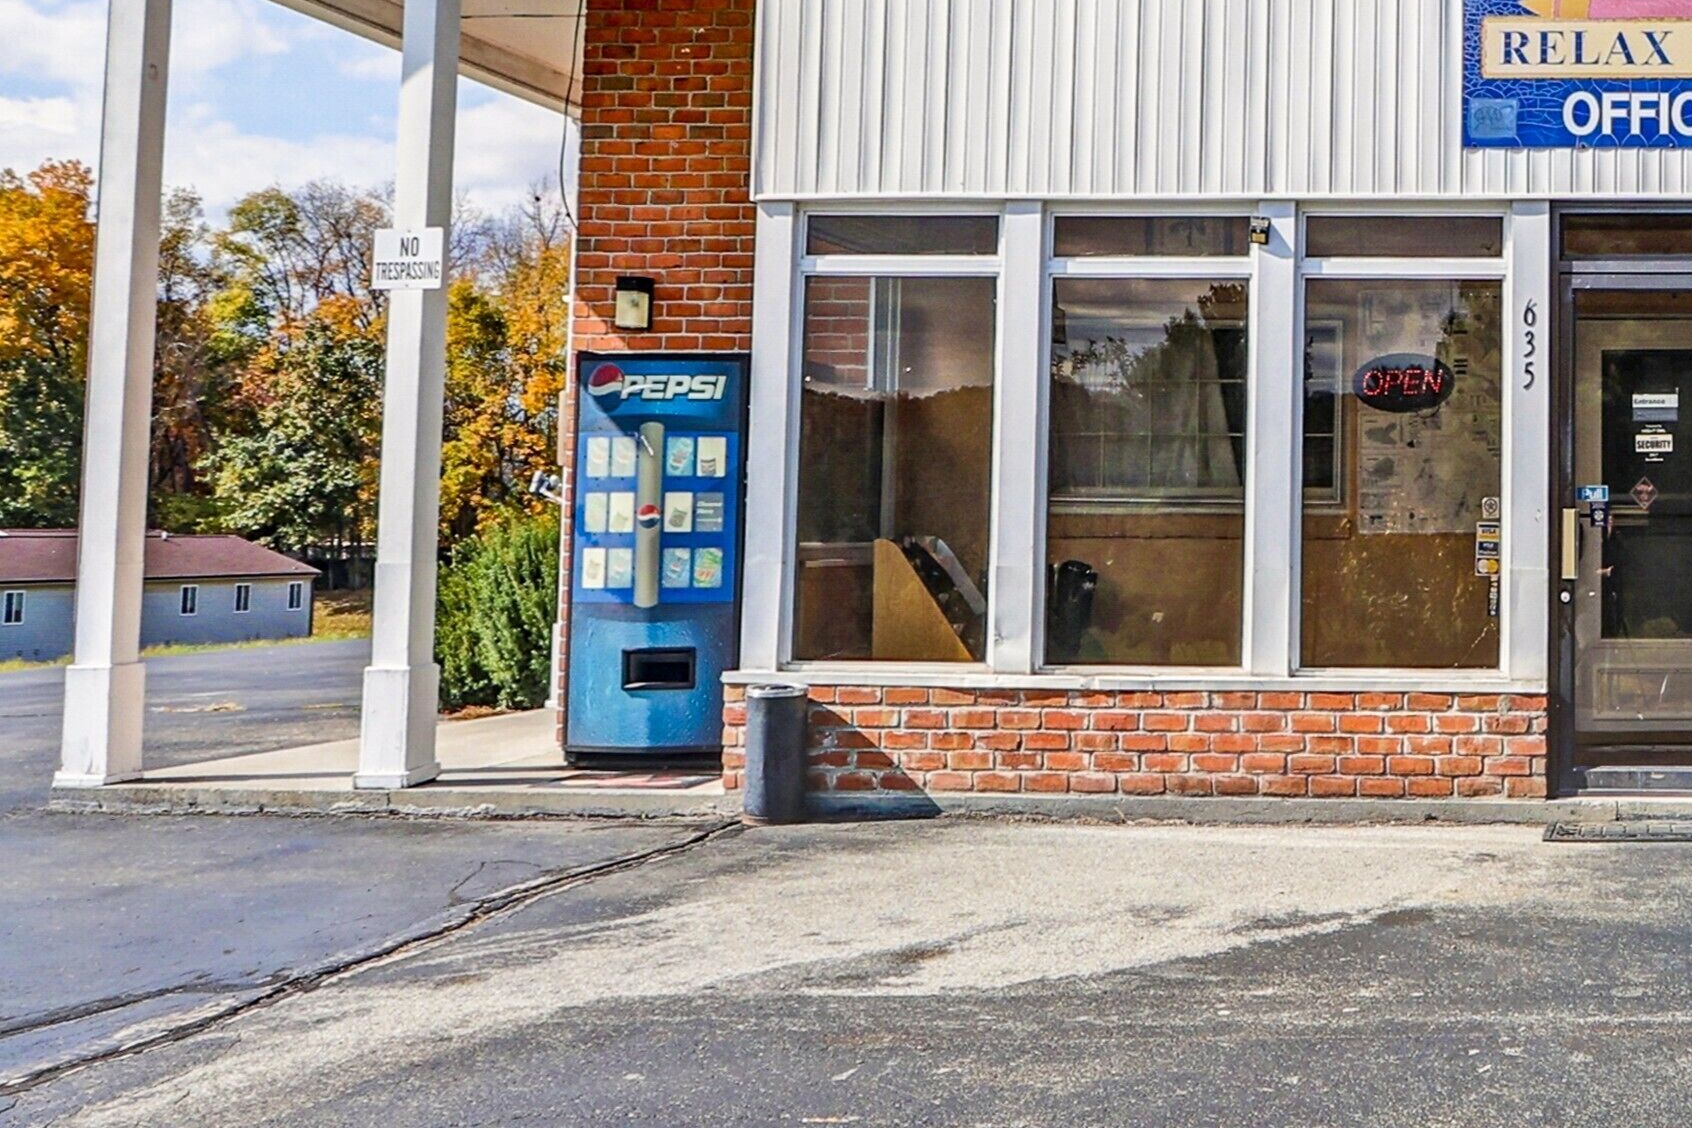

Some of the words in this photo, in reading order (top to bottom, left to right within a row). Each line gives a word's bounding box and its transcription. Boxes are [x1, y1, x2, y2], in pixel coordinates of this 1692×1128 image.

[1500, 30, 1673, 66] RELAX
[400, 236, 419, 257] NO
[376, 260, 440, 280] TRESPASSING
[620, 375, 727, 400] PEPSI
[1362, 369, 1444, 396] OPEN
[1636, 440, 1672, 450] SECURITY
